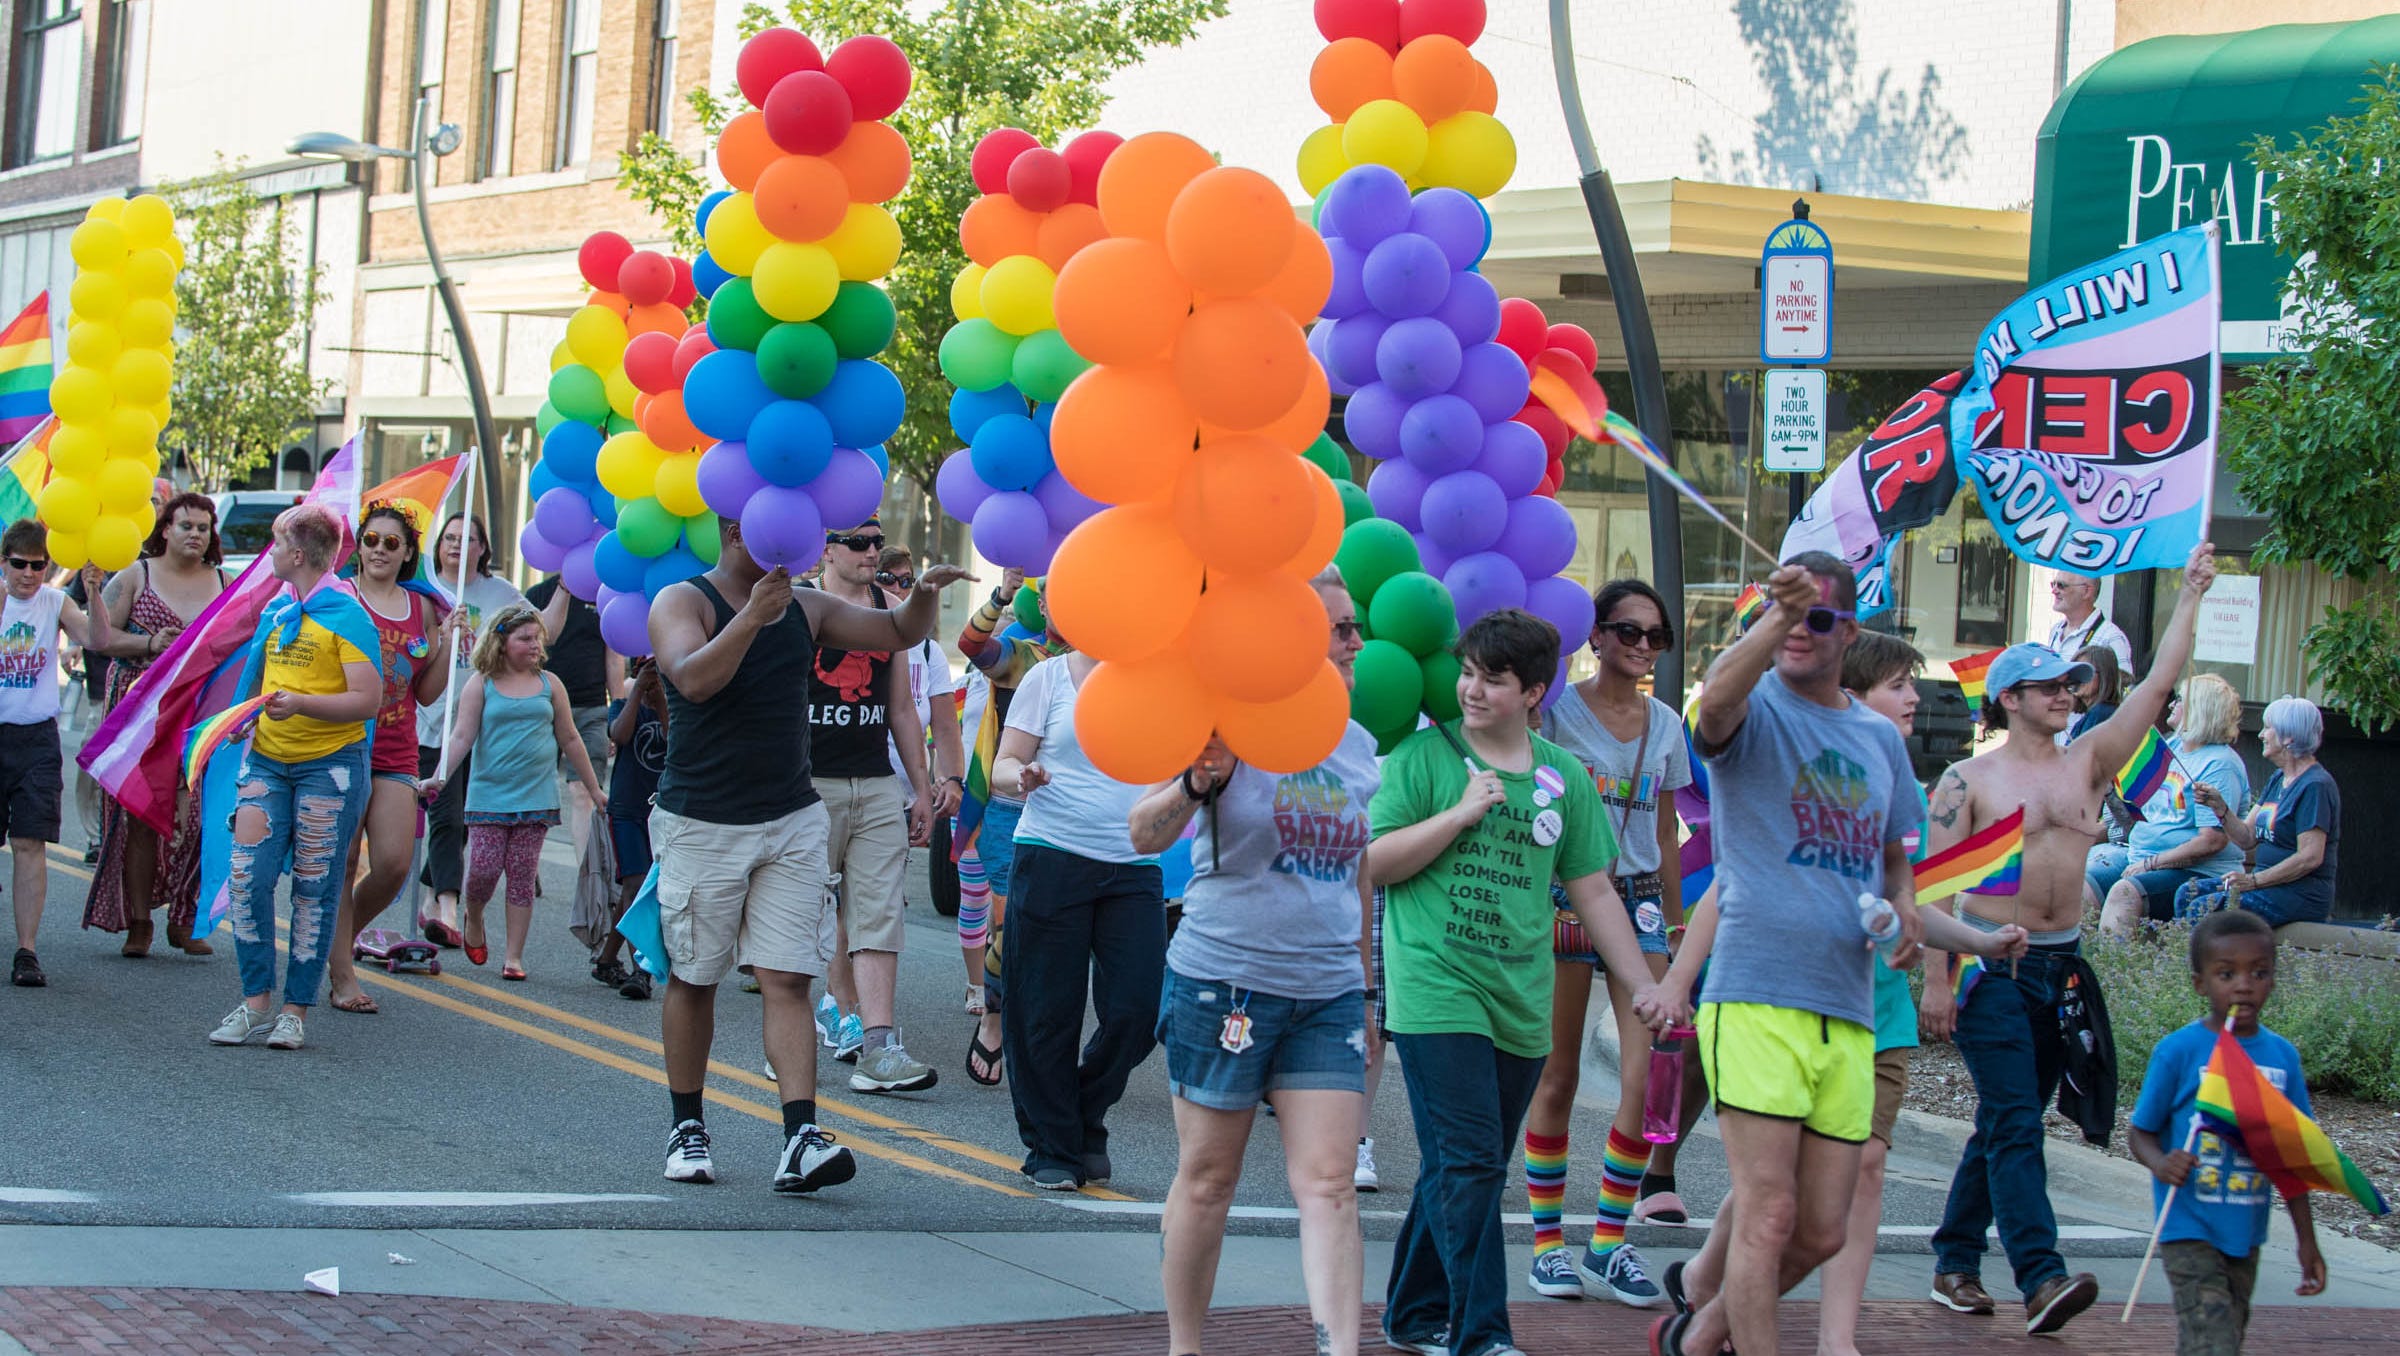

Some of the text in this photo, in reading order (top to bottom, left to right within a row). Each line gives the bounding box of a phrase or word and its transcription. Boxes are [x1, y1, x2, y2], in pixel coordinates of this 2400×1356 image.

[2119, 134, 2284, 250] PEAR
[1789, 279, 1804, 292] NO
[1775, 294, 1817, 307] PARKING
[1775, 309, 1818, 322] ANYTIME
[1784, 386, 1805, 399] TWO
[1781, 400, 1809, 412] HOUR
[1773, 414, 1816, 427] PARKING
[1770, 430, 1819, 442] 6AM-9PM
[808, 704, 886, 726] LEG DAY
[1498, 804, 1534, 824] ALL
[1273, 812, 1369, 850] BATTLE
[1457, 840, 1491, 858] GAY
[1269, 846, 1364, 882] CREEK
[1452, 862, 1533, 890] SOMEONE
[1449, 883, 1502, 905] LOSES
[1450, 901, 1501, 928] THEIR
